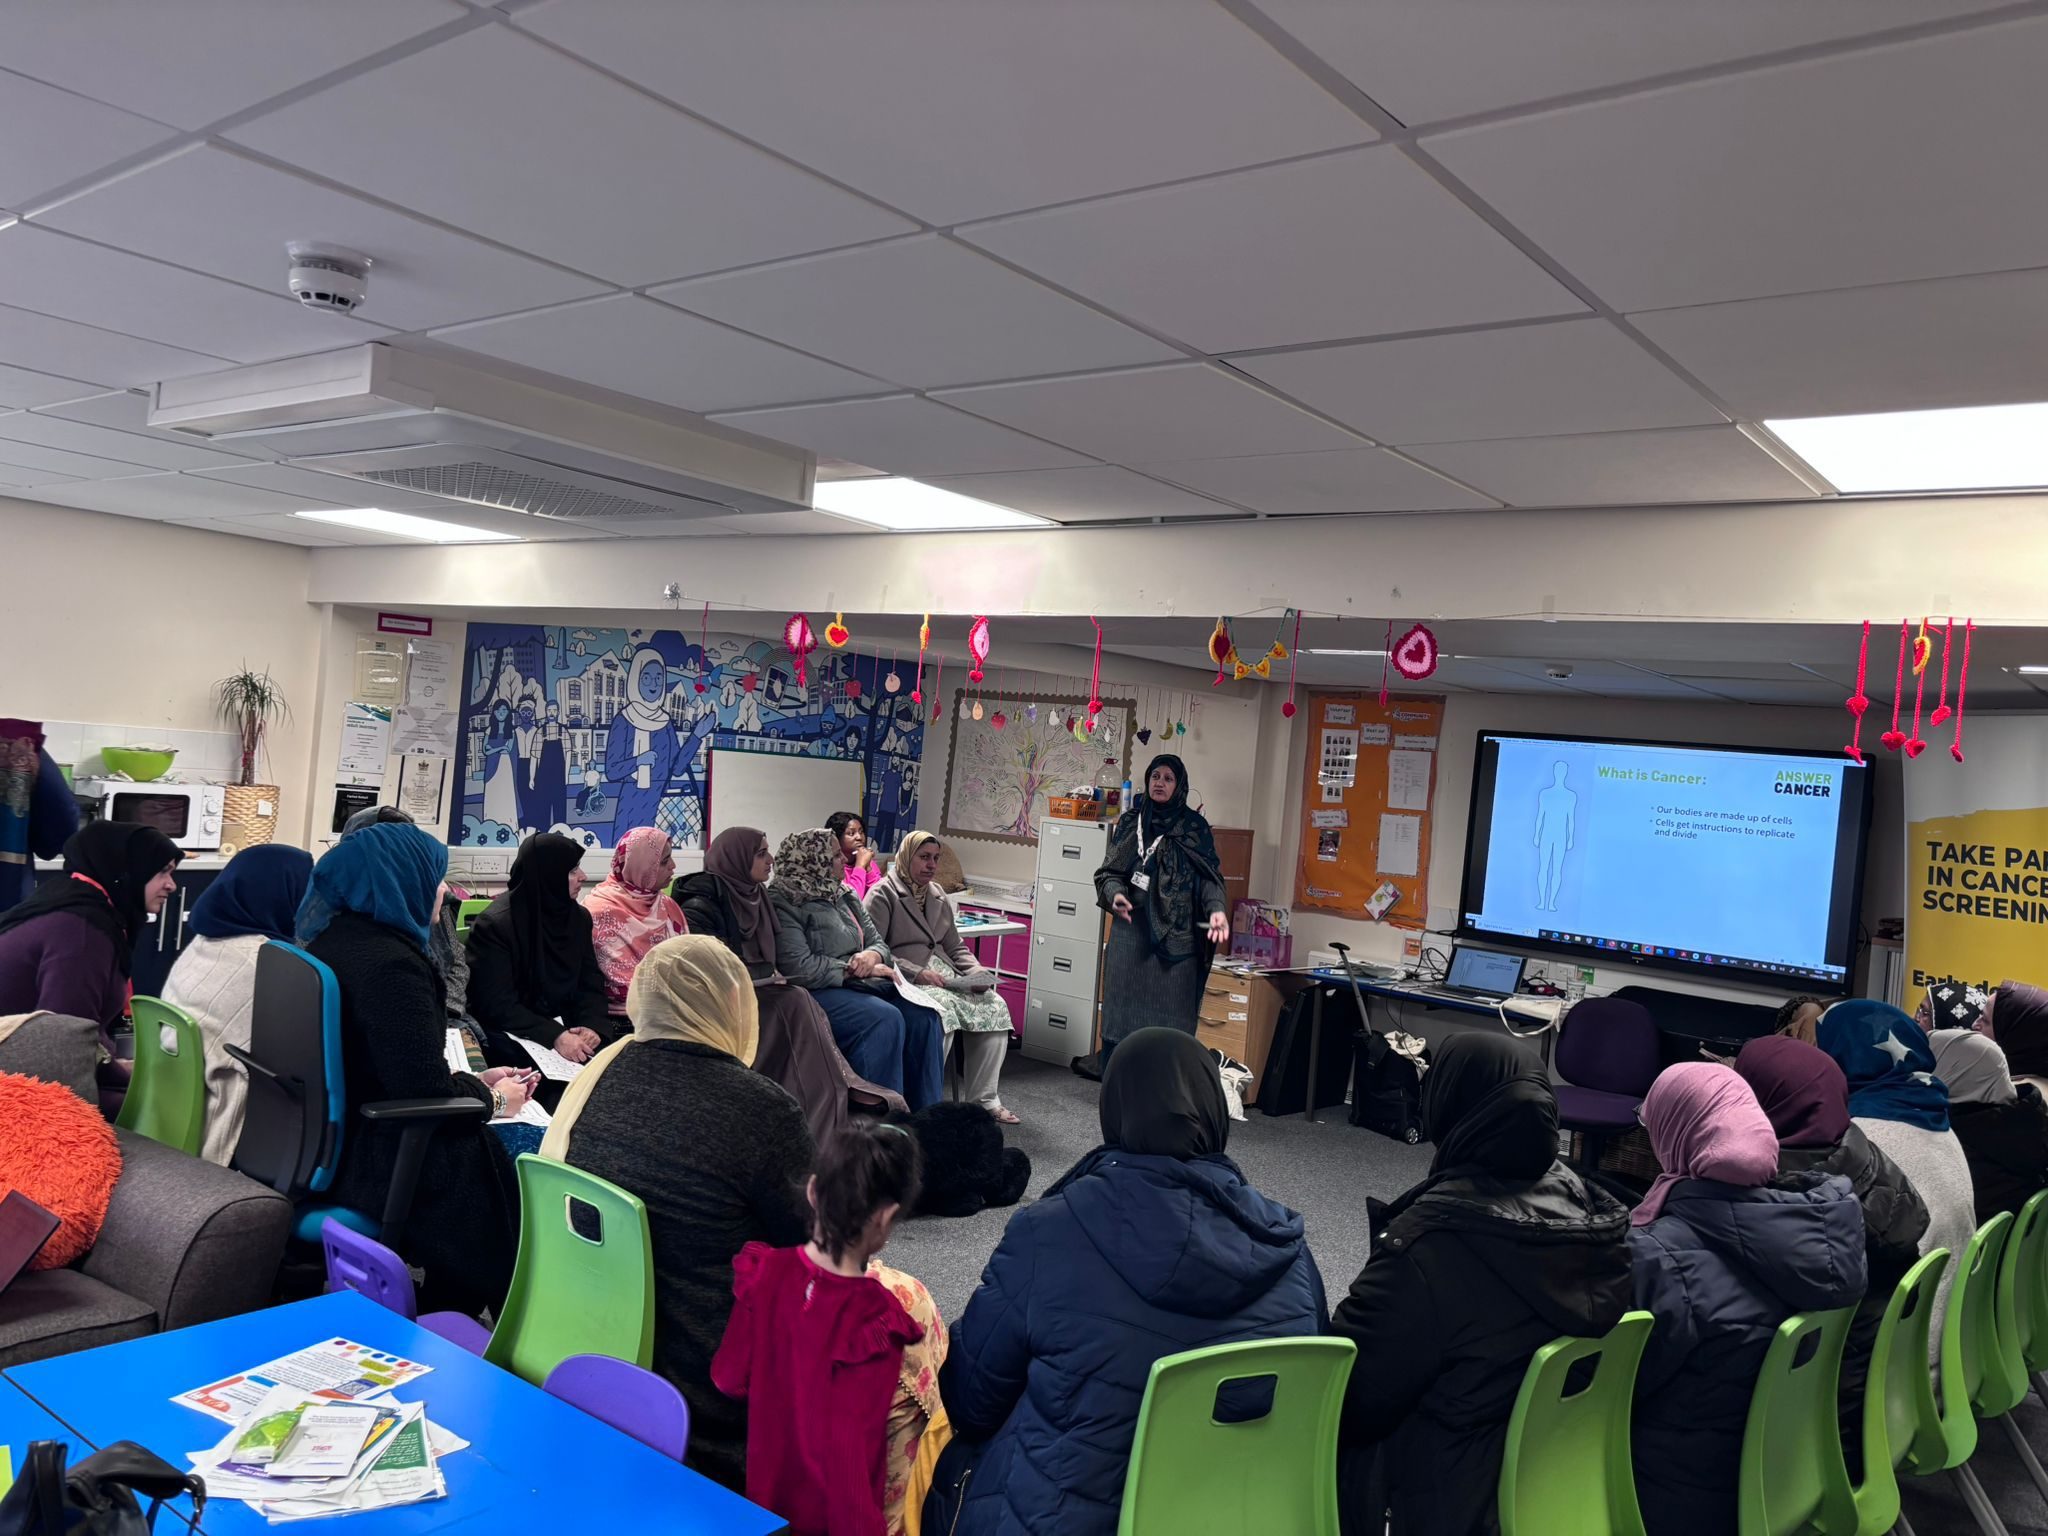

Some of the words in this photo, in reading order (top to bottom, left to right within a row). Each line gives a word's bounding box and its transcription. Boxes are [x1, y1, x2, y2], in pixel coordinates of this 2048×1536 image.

[1597, 765, 1634, 780] What
[1636, 768, 1648, 781] is
[1651, 770, 1708, 786] Cancer:
[1775, 770, 1832, 785] ANSWER
[1774, 783, 1831, 798] CANCER
[1656, 805, 1673, 815] Our
[1674, 806, 1703, 817] bodies
[1704, 810, 1719, 819] are
[1720, 810, 1746, 821] made
[1747, 814, 1760, 824] up
[1761, 814, 1772, 824] of
[1772, 815, 1793, 825] cells
[1654, 827, 1671, 837] and
[1672, 829, 1698, 840] divide
[1655, 818, 1675, 828] Cells
[1676, 820, 1690, 831] get
[1691, 821, 1743, 834] instructions
[1744, 826, 1754, 835] to
[1756, 827, 1796, 840] replicate
[1926, 841, 1996, 867] TAKE
[1927, 865, 1953, 888] IN
